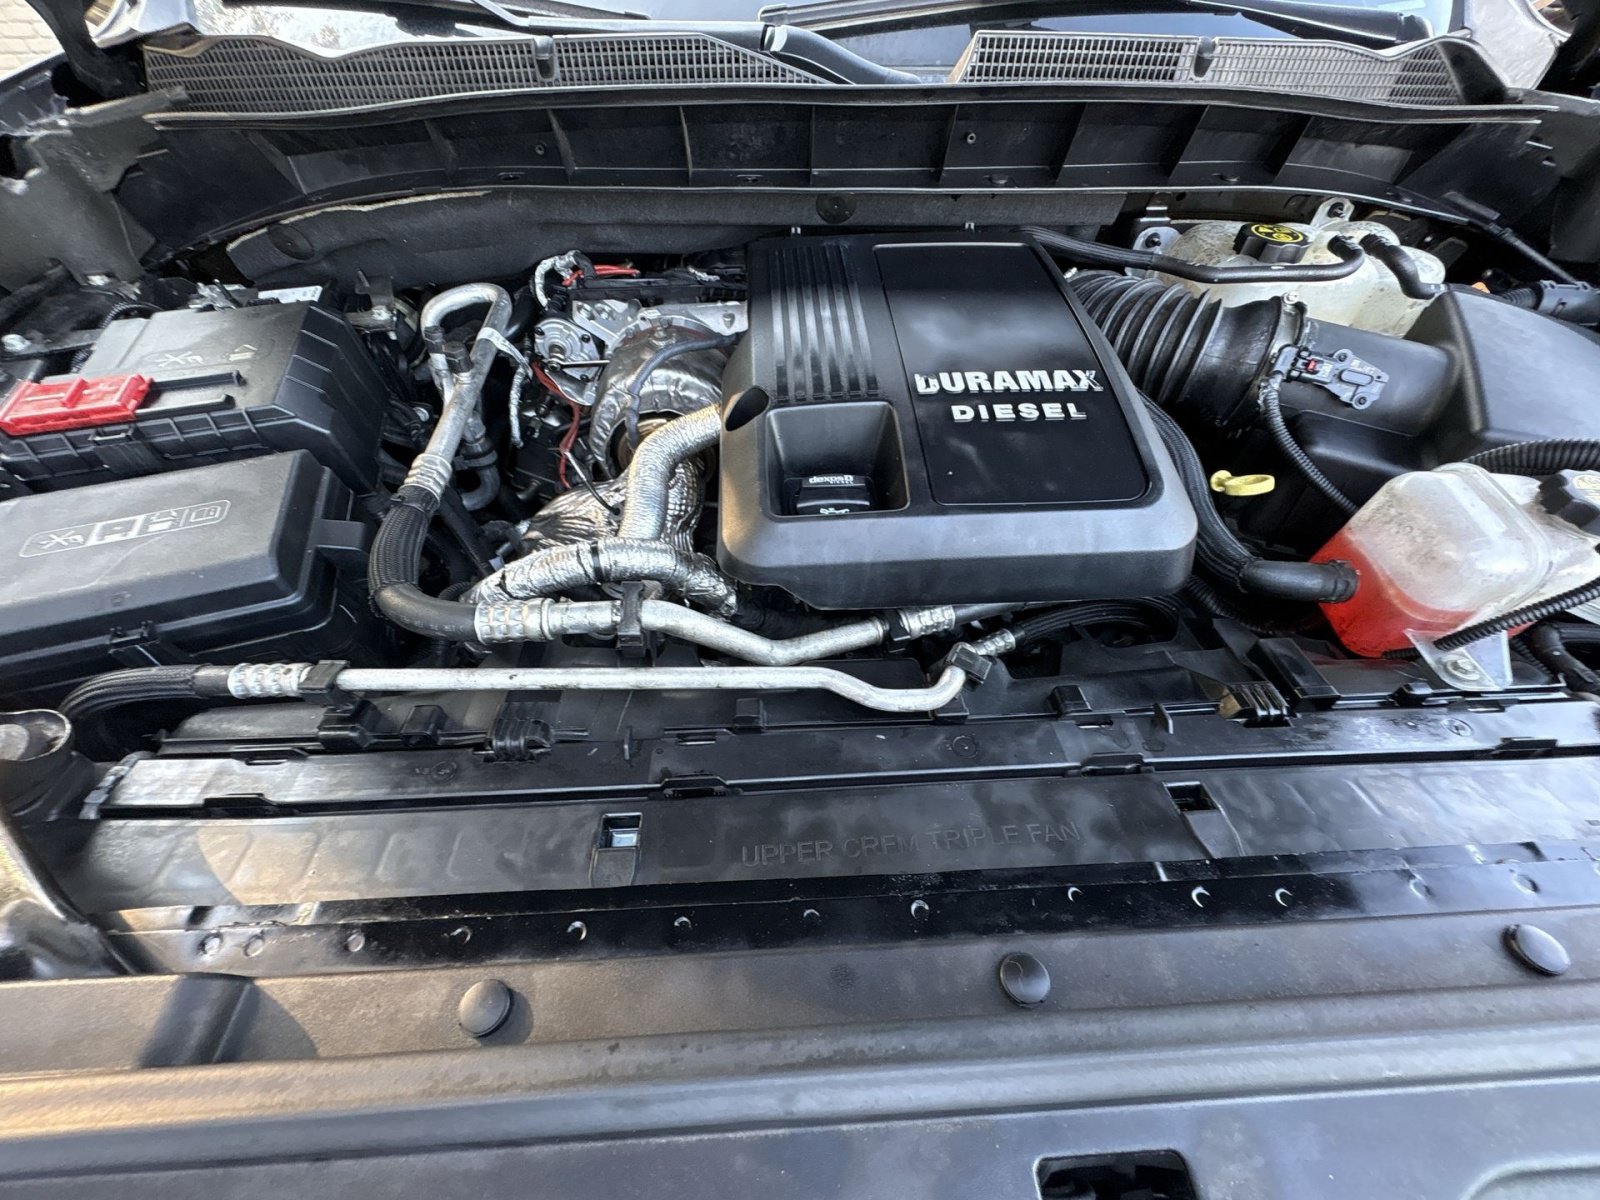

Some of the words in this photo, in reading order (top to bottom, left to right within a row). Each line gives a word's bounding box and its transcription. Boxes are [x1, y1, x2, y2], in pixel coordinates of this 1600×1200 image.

[914, 369, 1104, 395] DURAMAX
[951, 402, 1088, 422] DIESEL
[741, 840, 833, 868] UPPER
[928, 824, 1020, 851] TRIPLE
[1027, 820, 1081, 844] FAN
